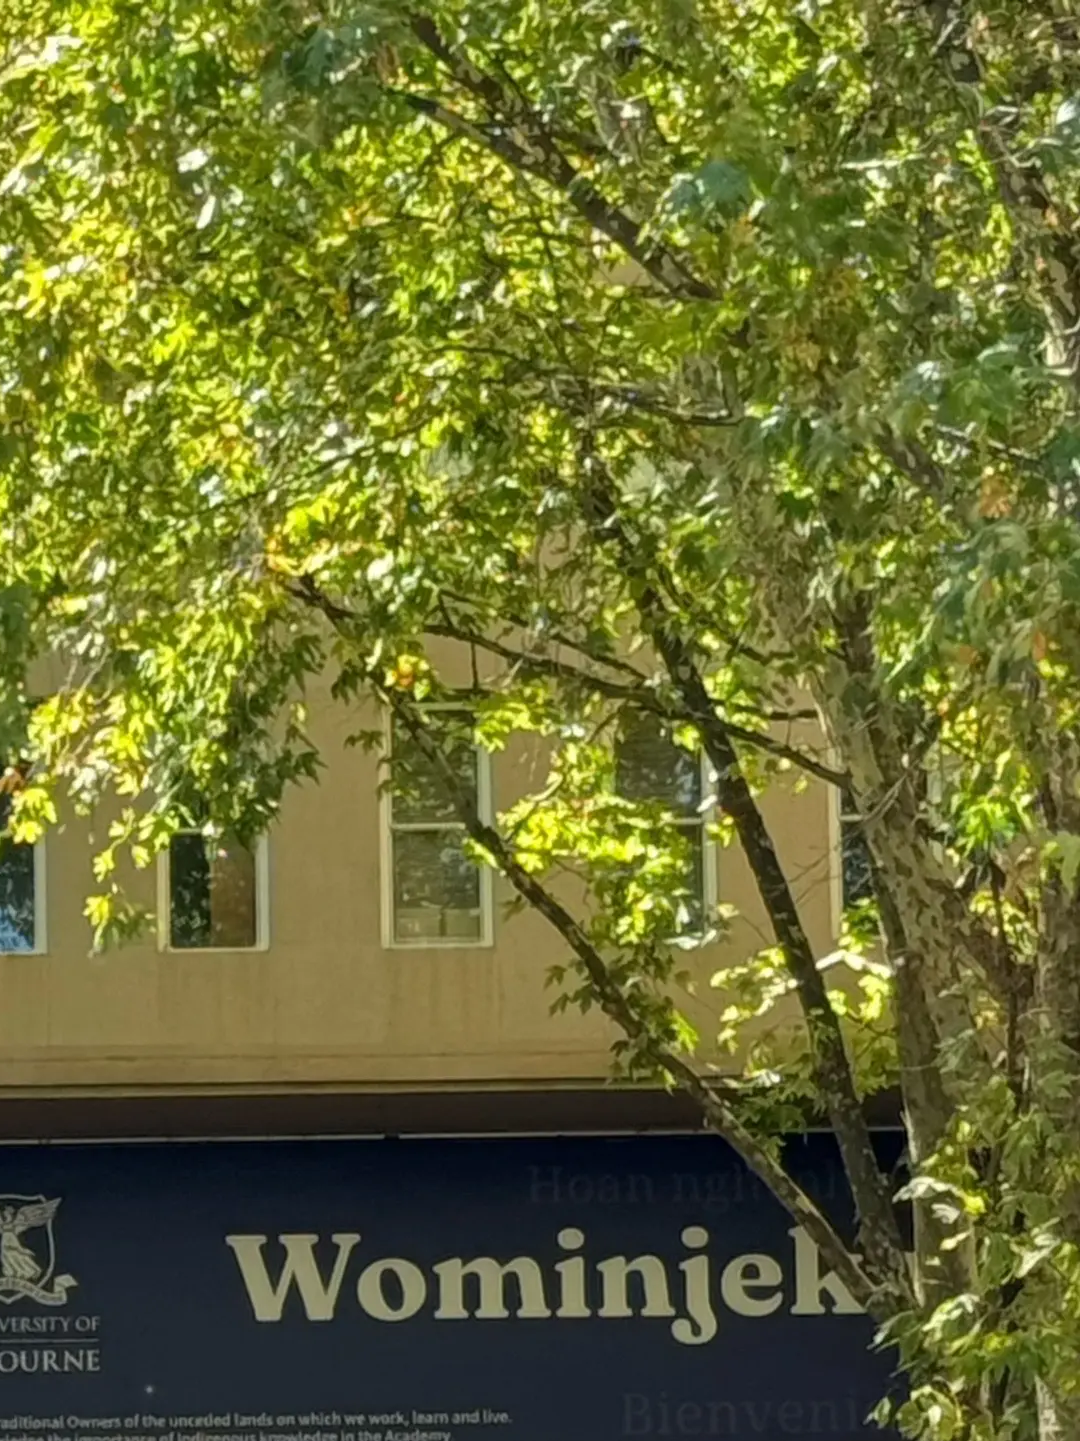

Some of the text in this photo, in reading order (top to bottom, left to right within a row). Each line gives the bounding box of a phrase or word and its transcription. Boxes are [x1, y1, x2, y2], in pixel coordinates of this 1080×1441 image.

[527, 1163, 656, 1206] Hoan
[226, 1225, 867, 1345] Wominjek
[75, 1315, 100, 1331] OF
[67, 1416, 121, 1429] Owners
[124, 1413, 140, 1428] of
[142, 1413, 166, 1428] the
[169, 1412, 230, 1428] unceded
[234, 1412, 274, 1427] lands
[276, 1415, 295, 1426] on
[297, 1411, 342, 1426] which
[344, 1414, 366, 1425] we
[368, 1411, 409, 1427] work,
[412, 1409, 448, 1424] learn
[452, 1409, 479, 1424] and
[482, 1408, 512, 1423] live.
[620, 1390, 864, 1437] Bienveni
